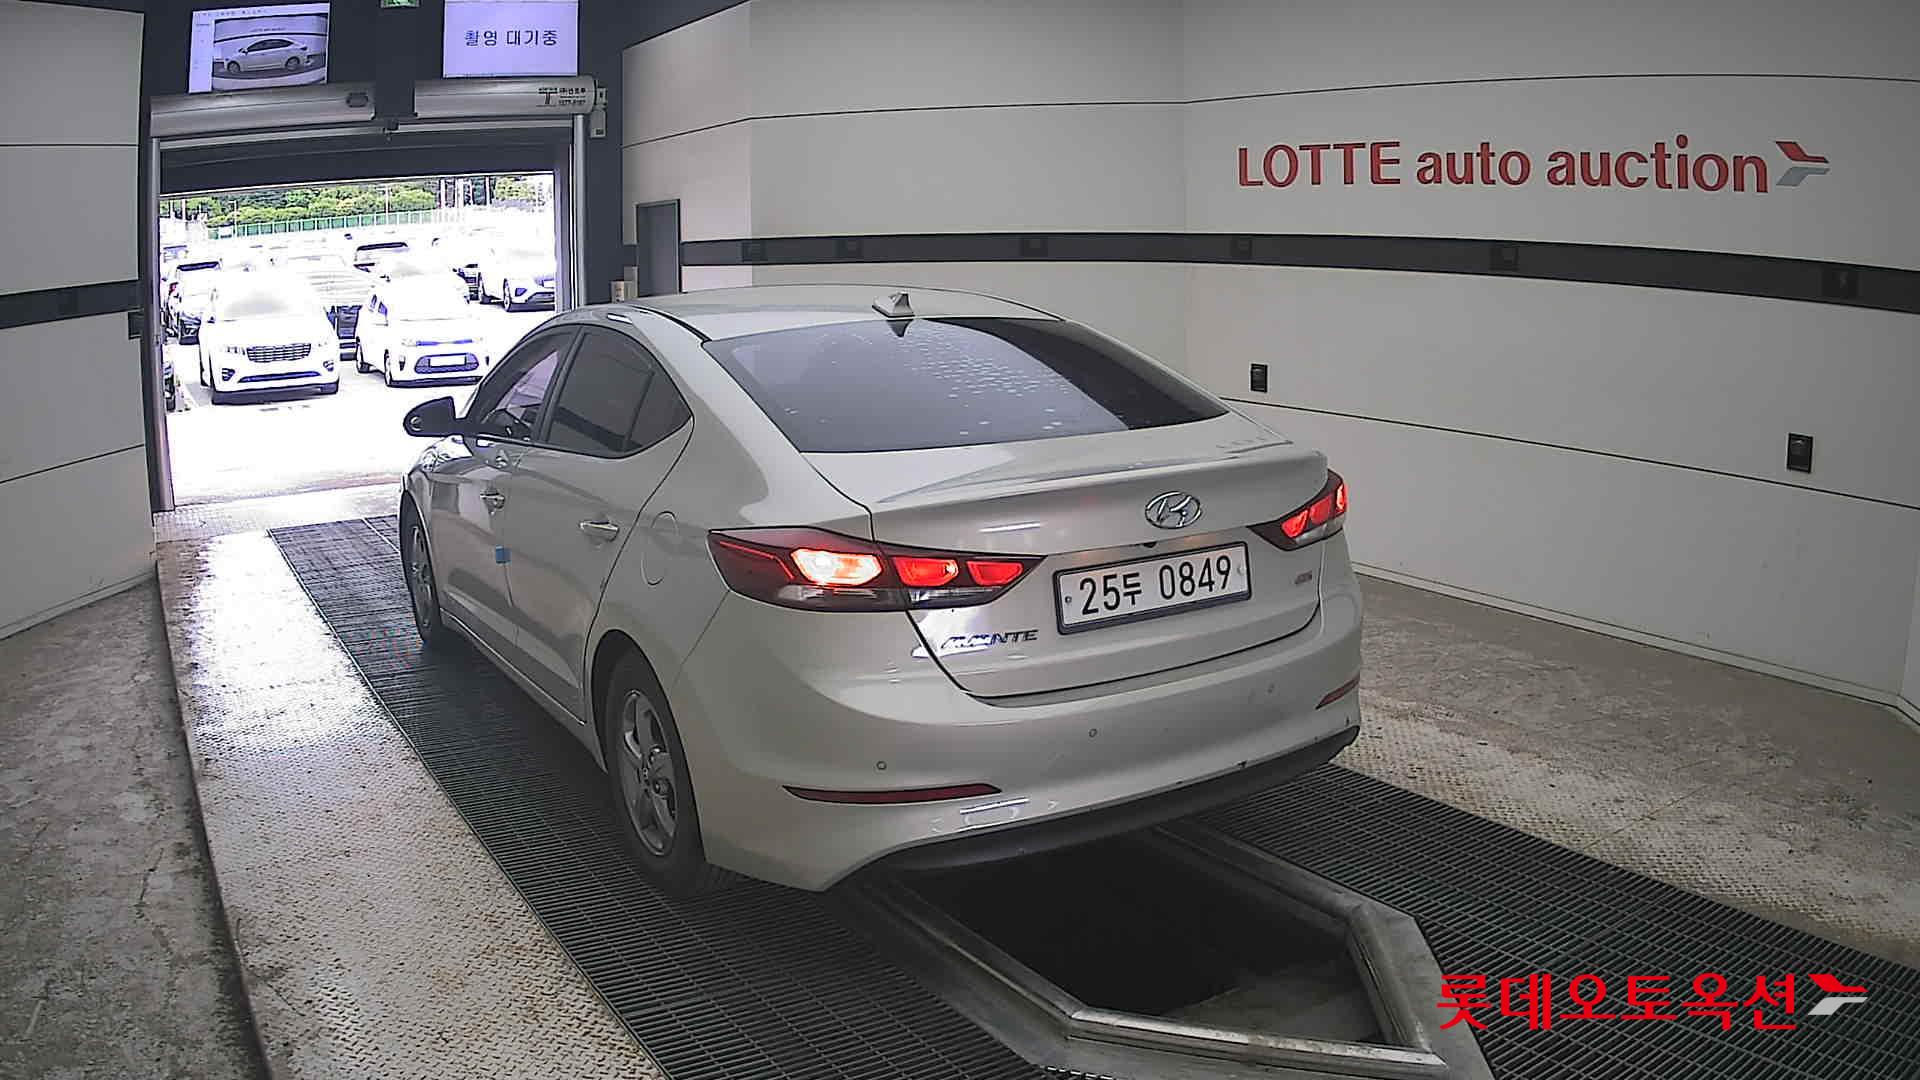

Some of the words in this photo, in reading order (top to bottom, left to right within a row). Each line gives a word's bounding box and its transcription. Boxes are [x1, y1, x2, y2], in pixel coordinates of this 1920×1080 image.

[465, 30, 497, 46] 촬영
[506, 30, 557, 46] 대기중
[1238, 141, 1401, 188] LOTTE
[1416, 142, 1531, 186] auto
[1547, 134, 1769, 193] auction
[1079, 572, 1142, 616] 25두
[1158, 555, 1232, 600] 0849
